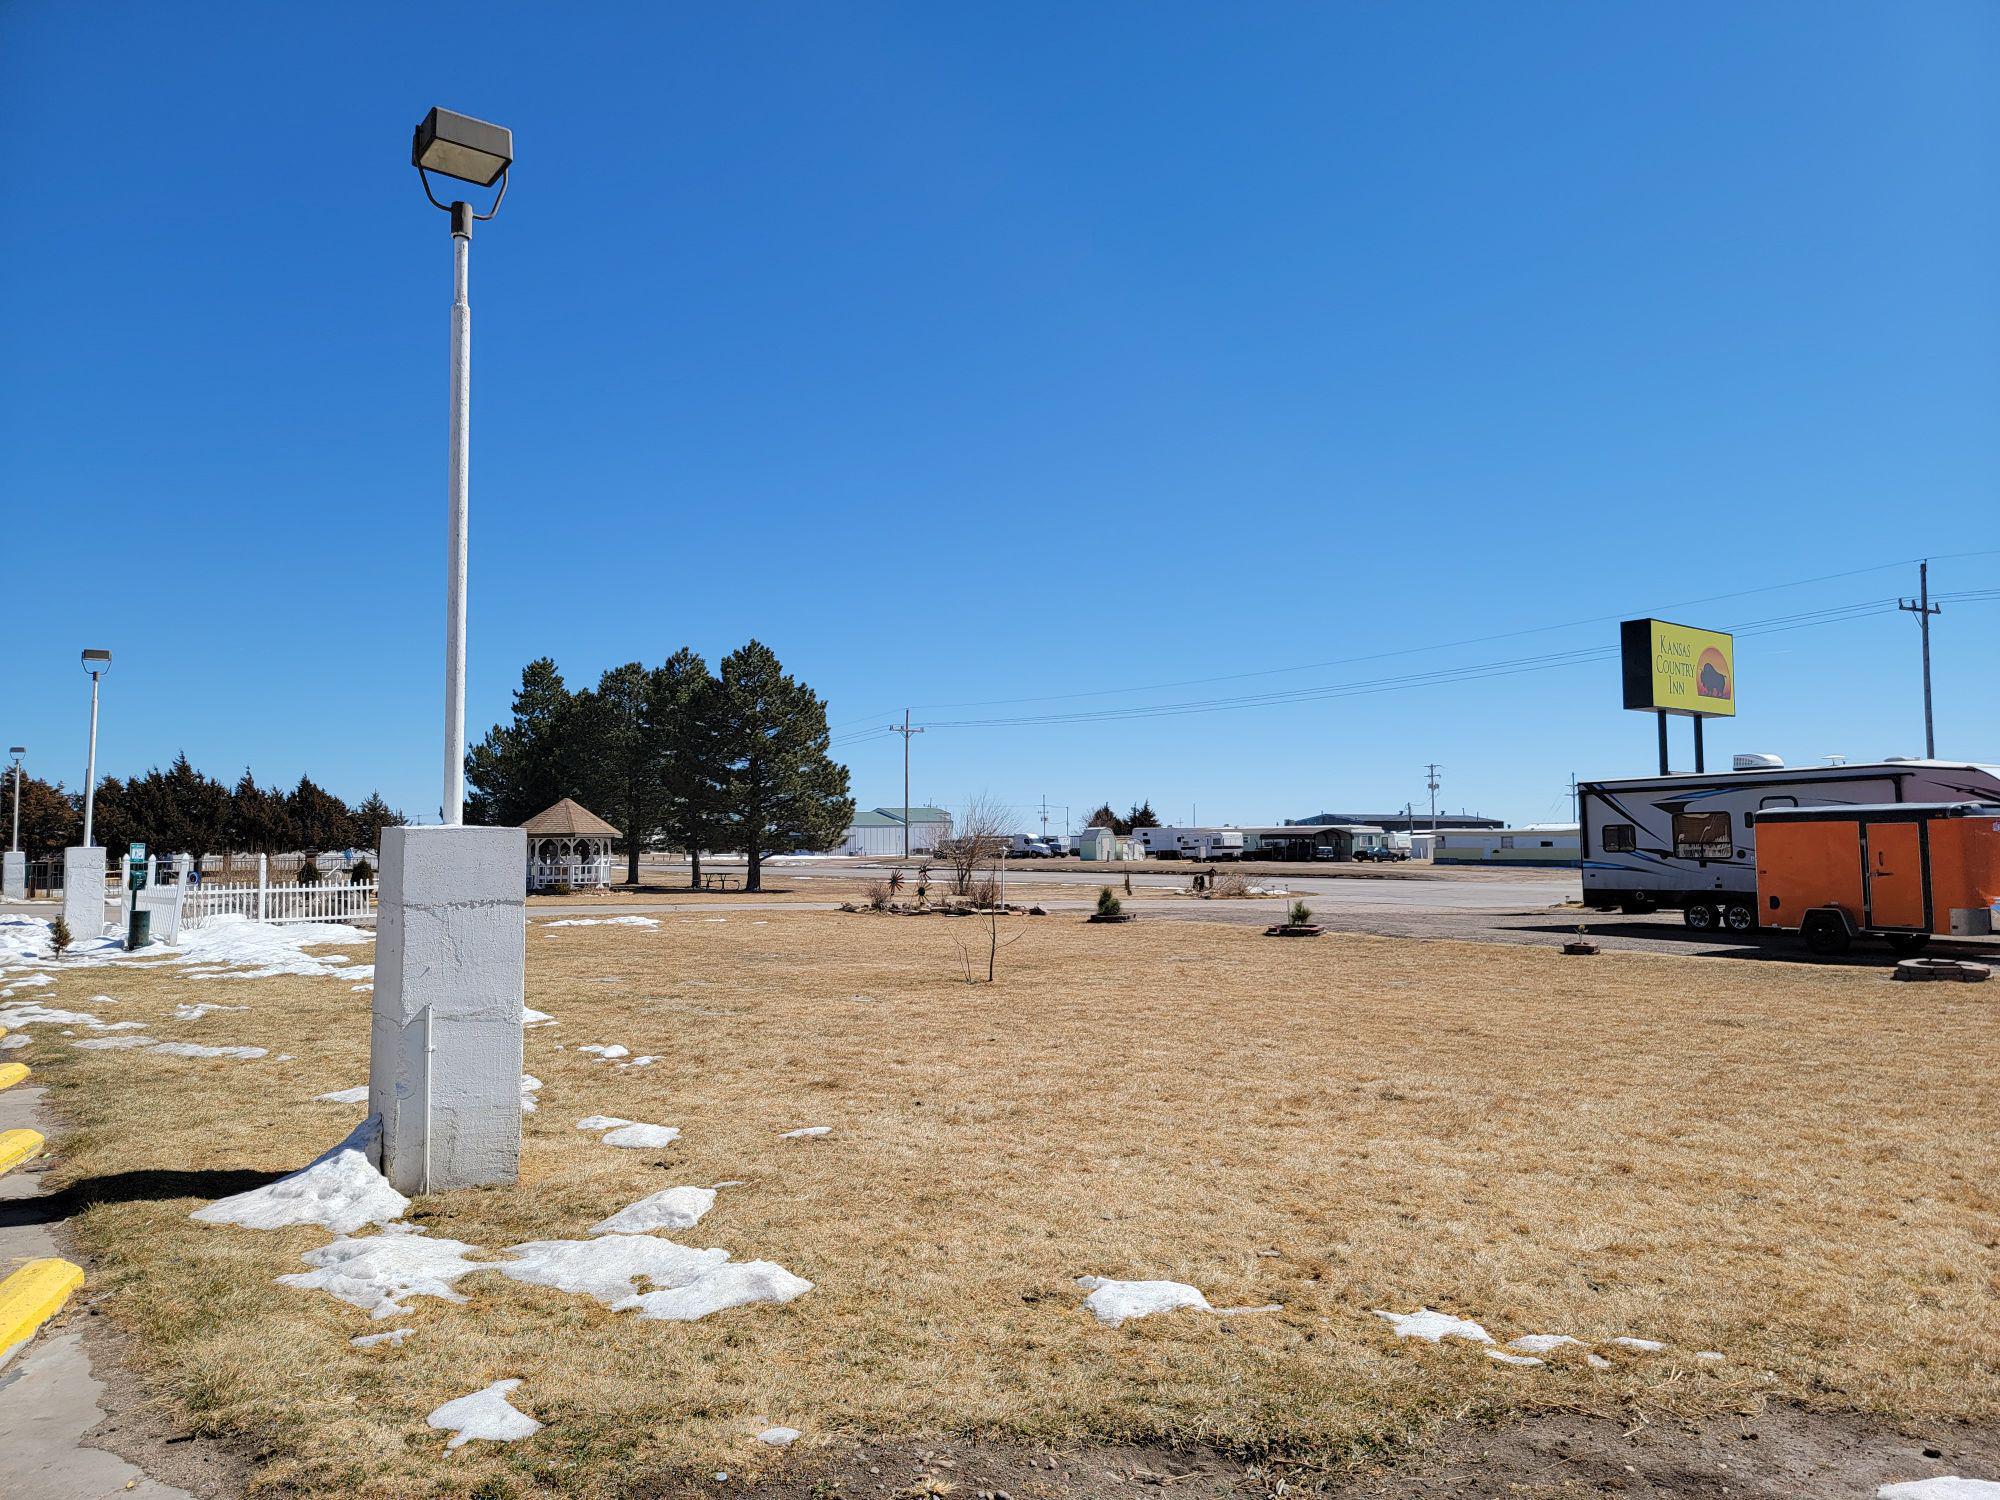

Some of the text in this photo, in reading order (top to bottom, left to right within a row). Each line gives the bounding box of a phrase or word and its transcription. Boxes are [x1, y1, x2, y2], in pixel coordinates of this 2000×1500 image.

[1660, 635, 1691, 657] KANSAS
[1656, 655, 1696, 678] COUNTRY
[1669, 676, 1685, 695] INN
